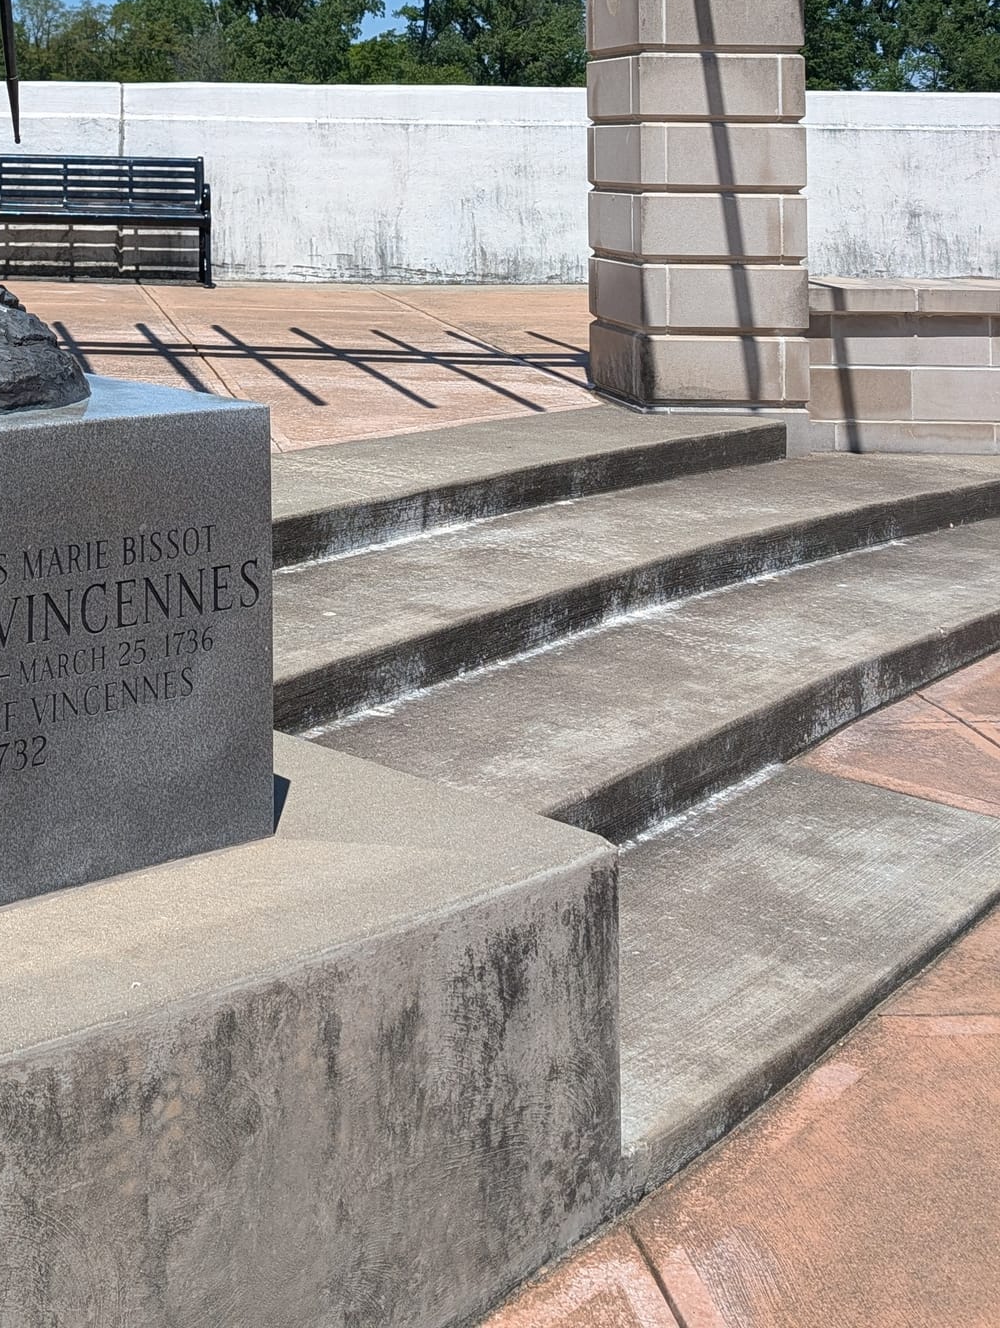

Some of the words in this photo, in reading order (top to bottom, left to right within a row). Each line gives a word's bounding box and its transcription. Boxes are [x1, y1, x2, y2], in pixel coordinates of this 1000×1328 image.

[22, 539, 110, 581] MARIE
[122, 524, 217, 566] BISSOT
[19, 646, 106, 687] MARCH
[163, 625, 214, 659] 1736
[30, 666, 195, 726] VINCENNES
